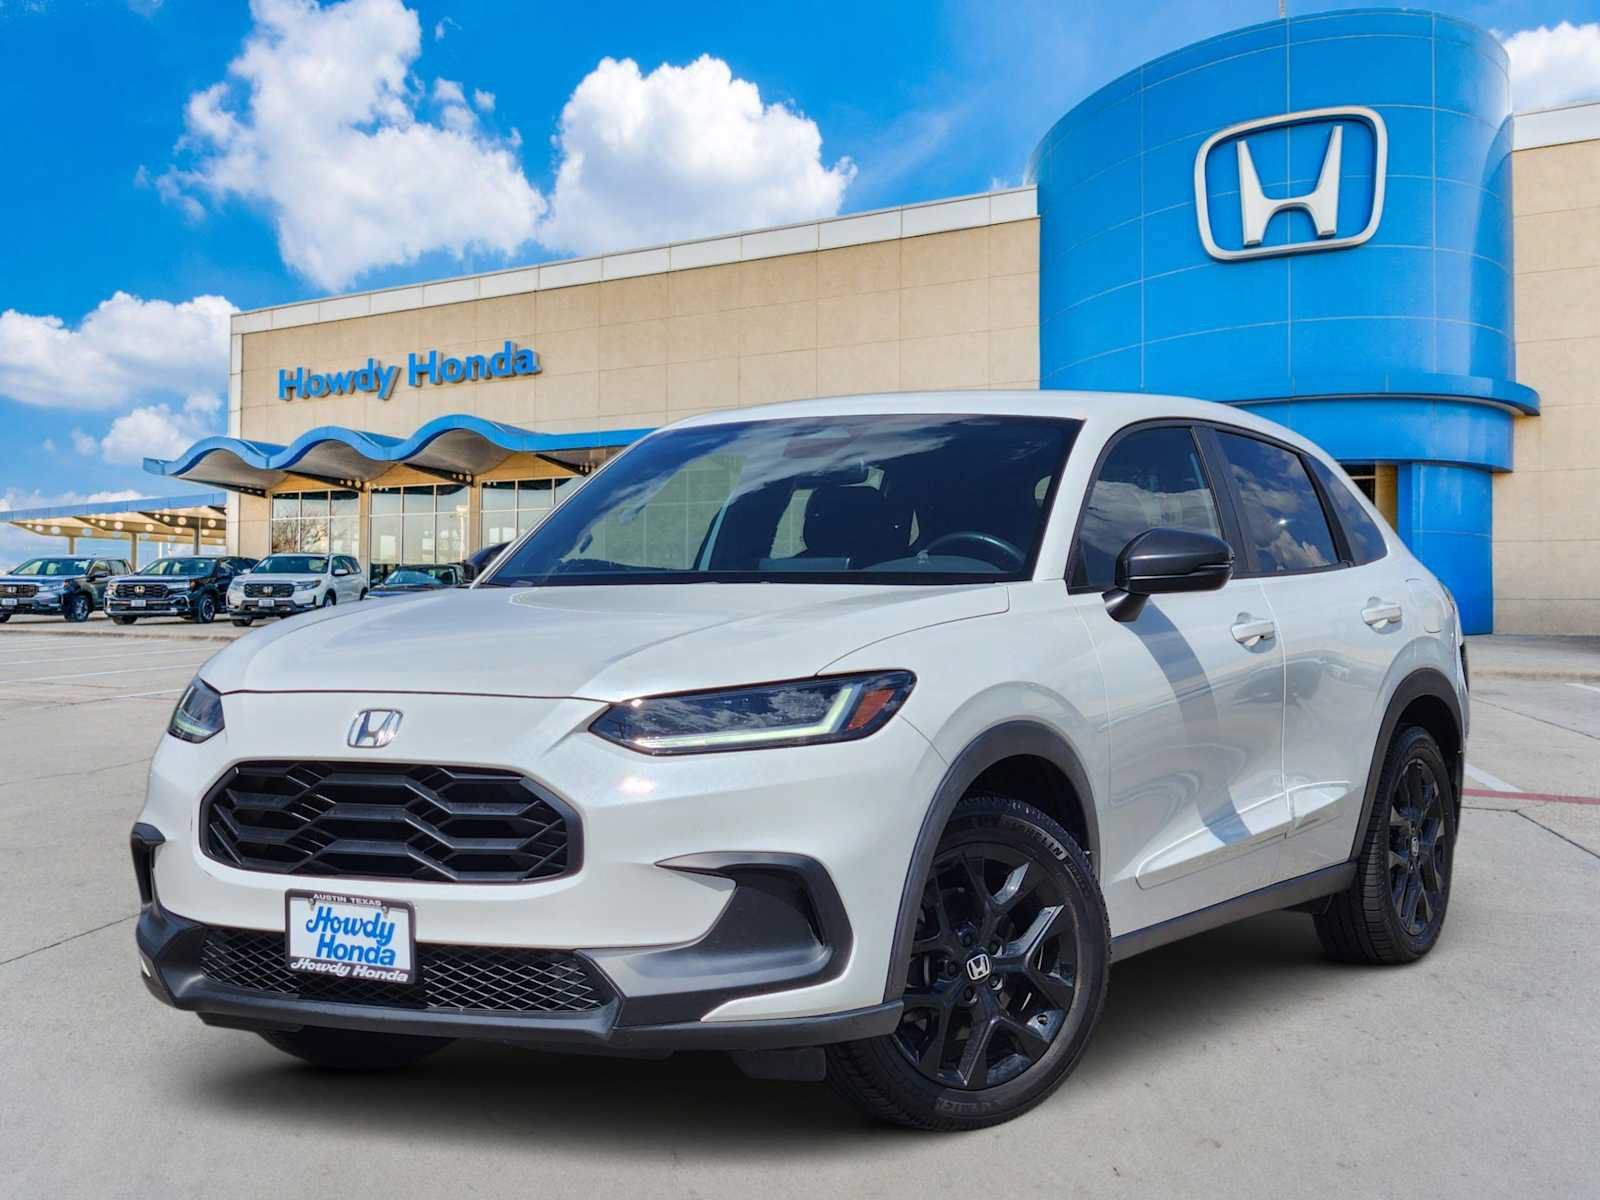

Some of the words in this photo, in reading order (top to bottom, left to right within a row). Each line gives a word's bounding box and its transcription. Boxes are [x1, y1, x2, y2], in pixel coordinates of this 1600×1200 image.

[278, 357, 400, 401] Howdy
[408, 340, 541, 388] Honda
[313, 893, 346, 903] AUSTIN
[350, 896, 382, 906] TEXAS
[305, 905, 396, 946] Howdy
[316, 933, 397, 966] Honda
[290, 957, 350, 977] Howdy
[352, 965, 409, 983] Honda
